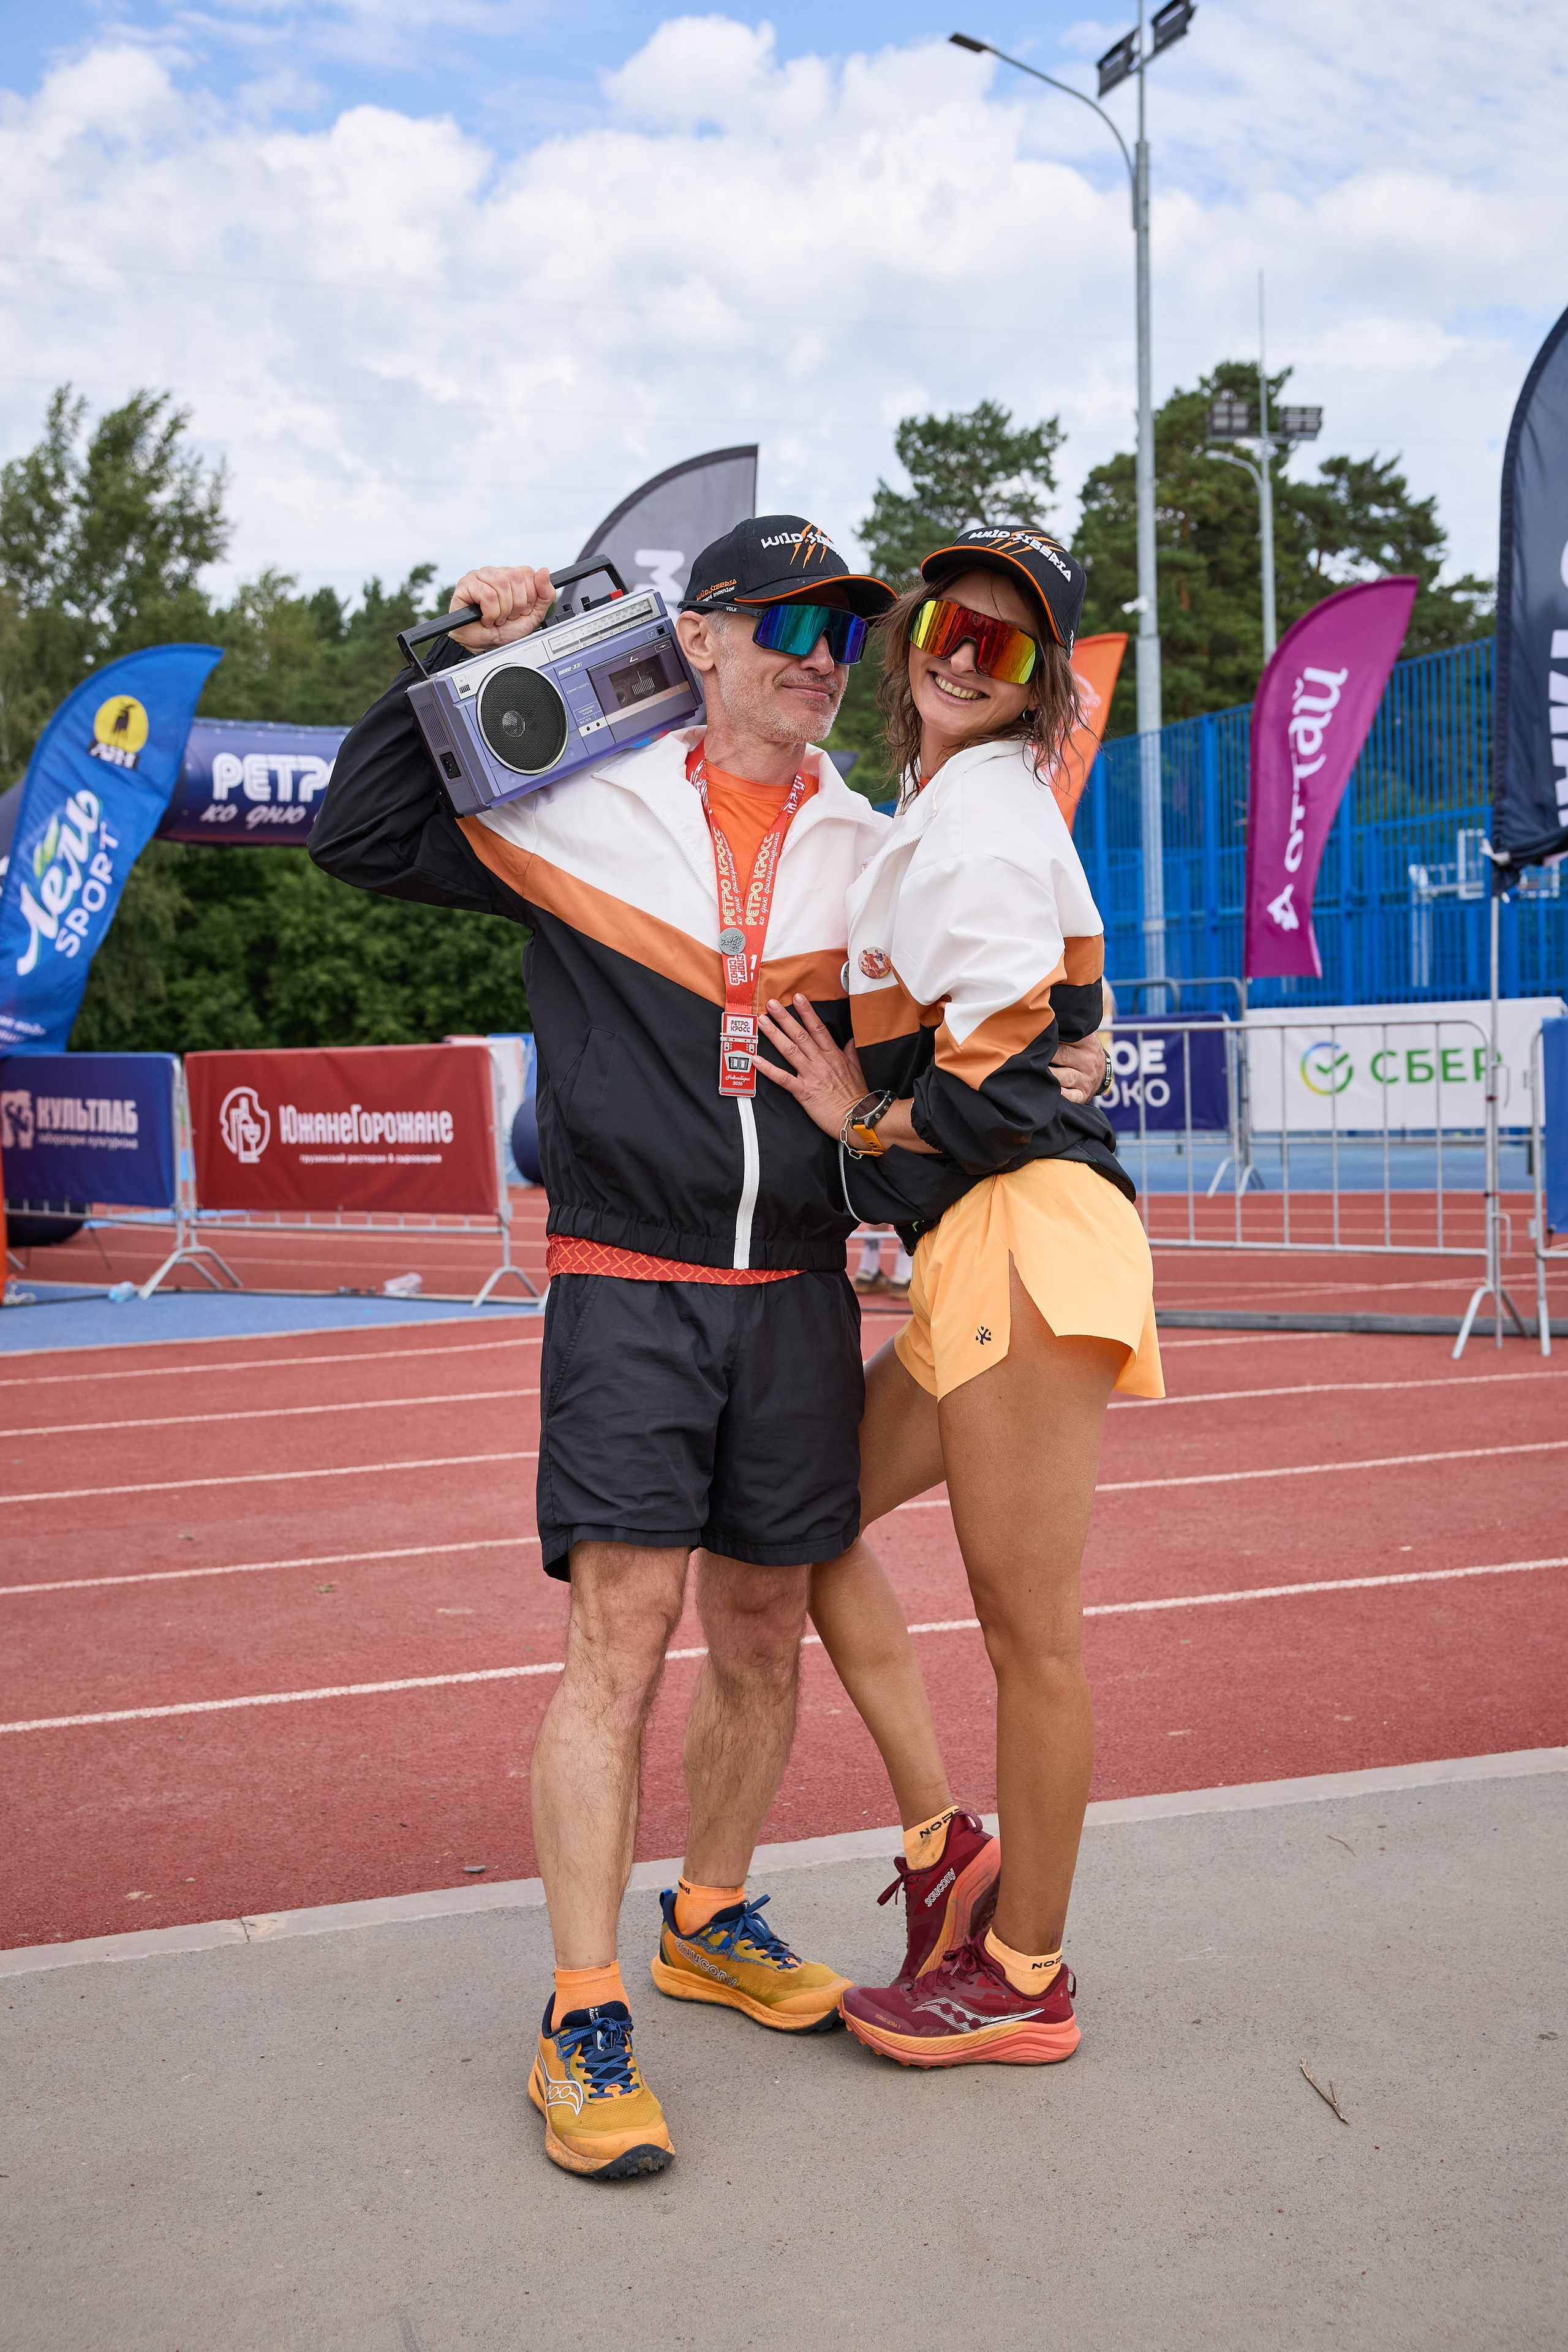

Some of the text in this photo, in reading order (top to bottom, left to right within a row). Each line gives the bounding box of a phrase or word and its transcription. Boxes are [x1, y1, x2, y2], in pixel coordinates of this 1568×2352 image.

[1012, 532, 1071, 582] SIBERIA
[709, 578, 737, 594] SIBERIA
[212, 752, 337, 802] РЕТР
[55, 821, 119, 958] SPORT
[713, 826, 736, 925] РЕТРО КРОСС
[745, 833, 774, 925] РЕТРО КРОСС
[759, 916, 765, 925] ко
[764, 832, 780, 894] физкультурника
[734, 896, 743, 913] дню
[736, 916, 743, 925] ко
[729, 959, 739, 984] СОЮЗ
[36, 1096, 139, 1134] КУЛЬТЛАБ
[919, 1808, 960, 1839] NOR
[924, 1868, 957, 1907] saucony
[674, 1937, 738, 1988] saucony
